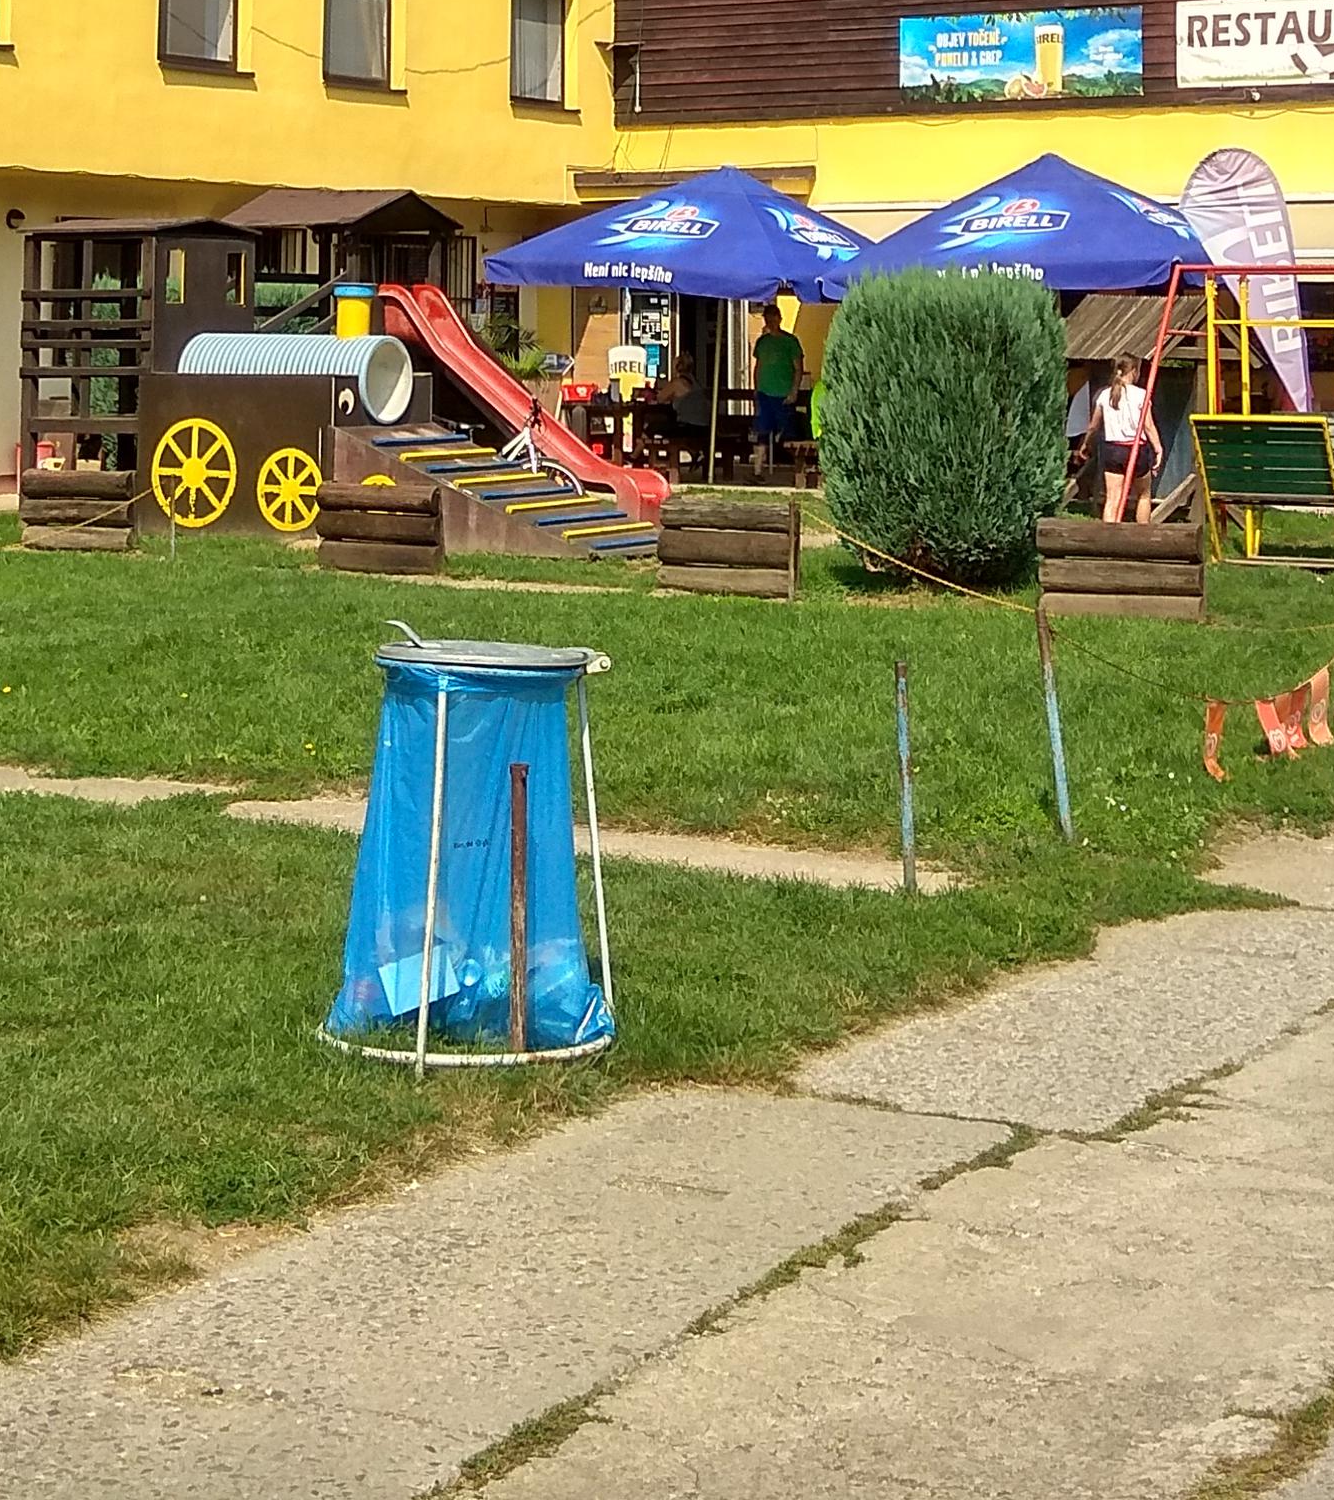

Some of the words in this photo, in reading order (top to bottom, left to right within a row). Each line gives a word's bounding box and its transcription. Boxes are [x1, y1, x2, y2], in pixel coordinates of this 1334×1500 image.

[936, 32, 966, 48] OBJEV
[631, 219, 703, 235] BIRELL
[970, 214, 1054, 231] BIRELL
[584, 262, 610, 278] Není
[611, 262, 628, 277] nic
[630, 262, 673, 284] lepšího
